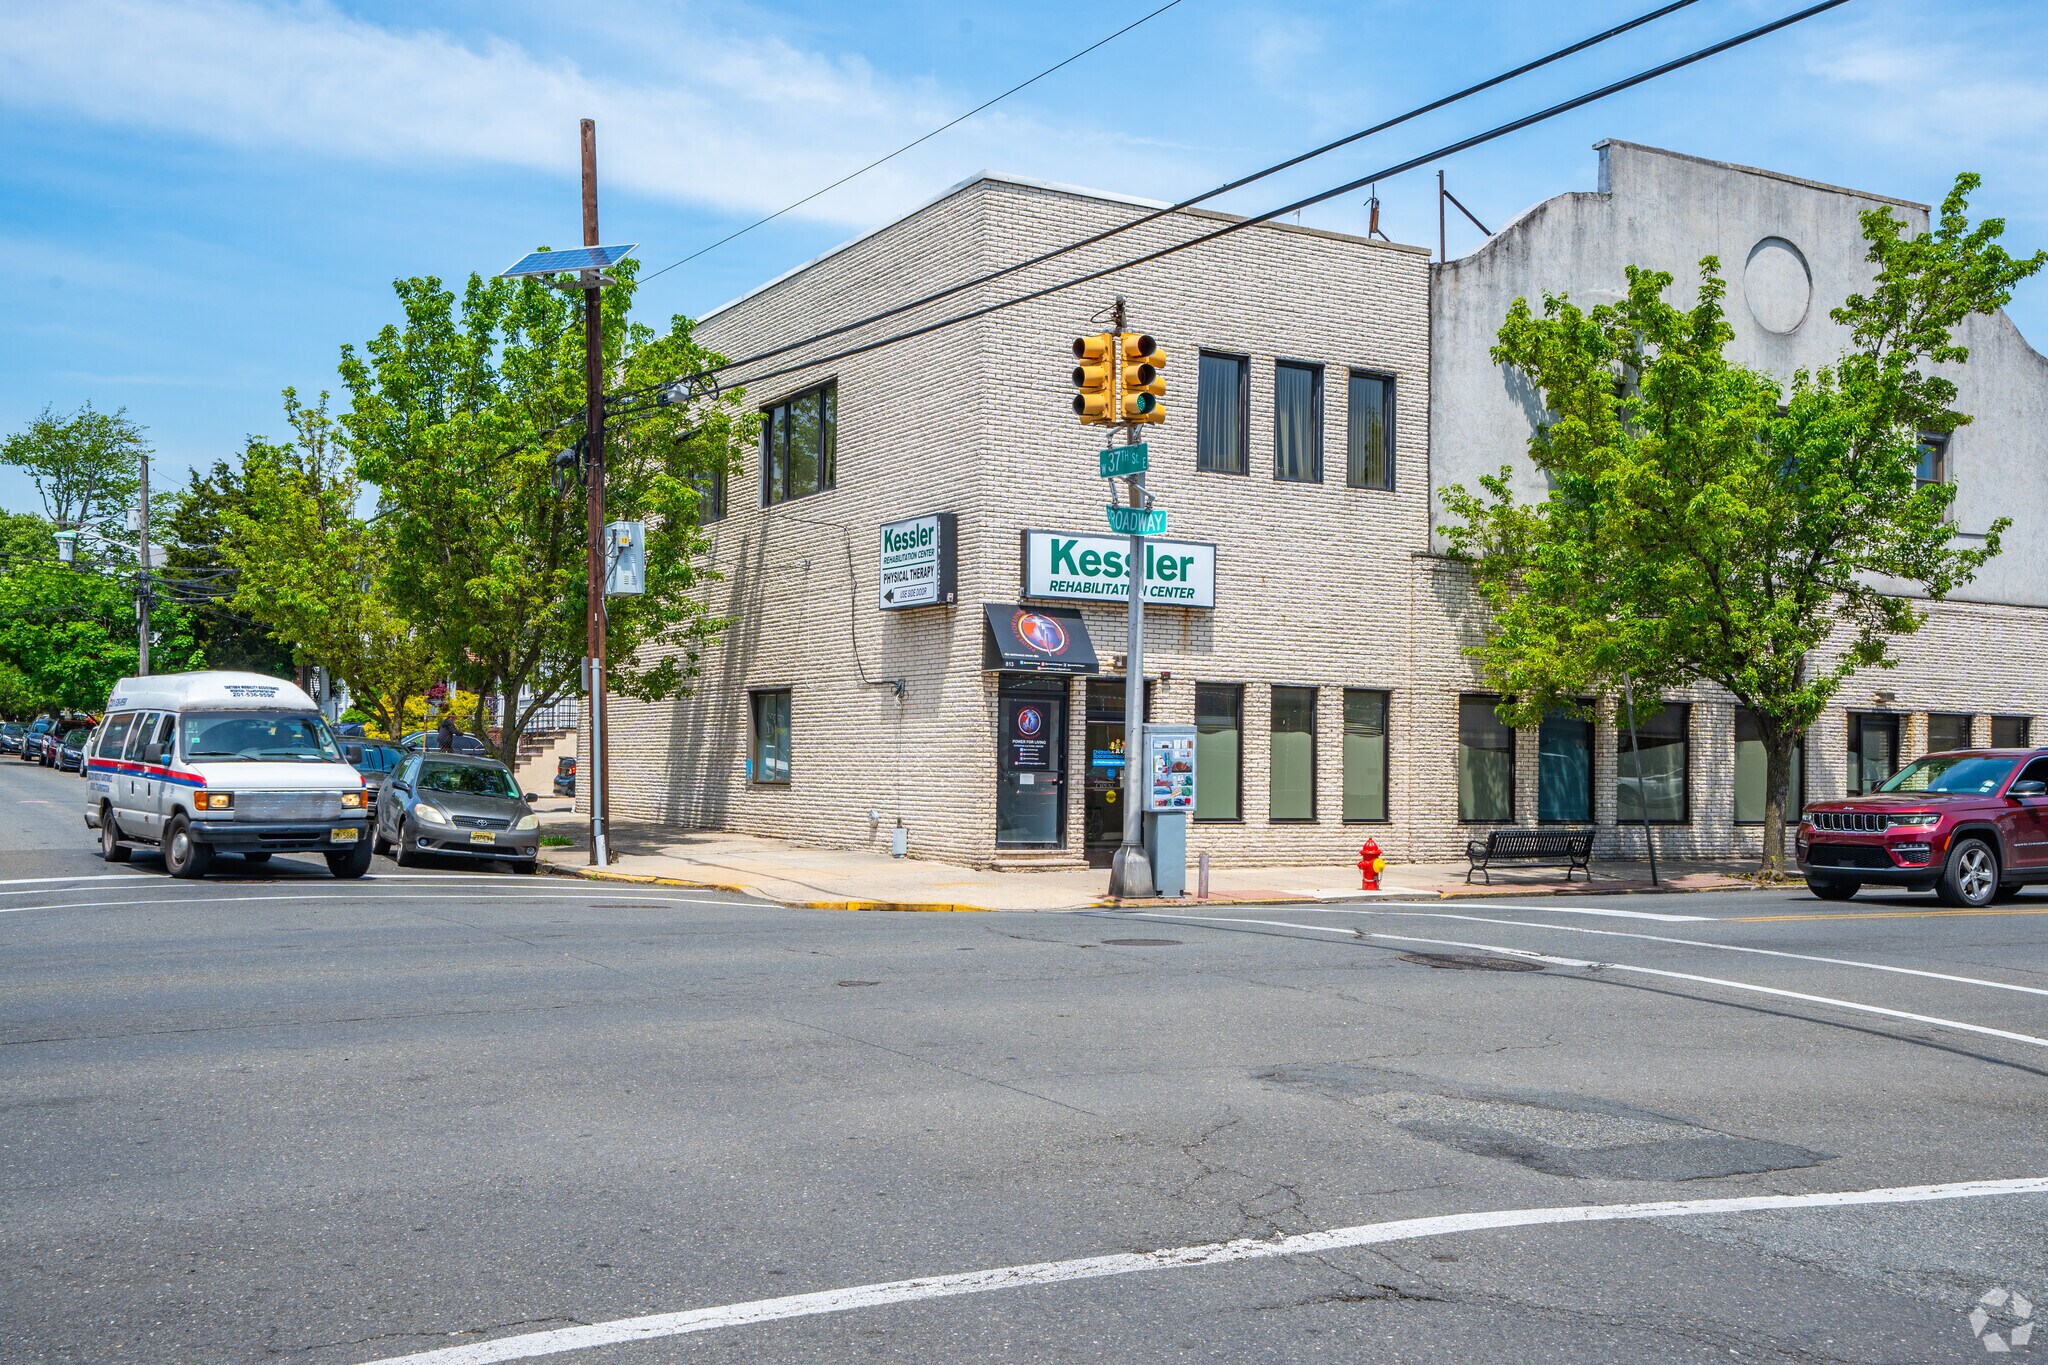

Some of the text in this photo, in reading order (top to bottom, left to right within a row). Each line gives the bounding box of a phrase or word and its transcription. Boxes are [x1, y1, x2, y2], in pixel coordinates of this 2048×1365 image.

[1142, 457, 1147, 469] E
[884, 523, 934, 553] Kessler
[883, 548, 935, 564] REHABILITATION CENTER
[883, 565, 935, 584] PHYSICAL THERAPY
[1149, 585, 1195, 599] CENTER
